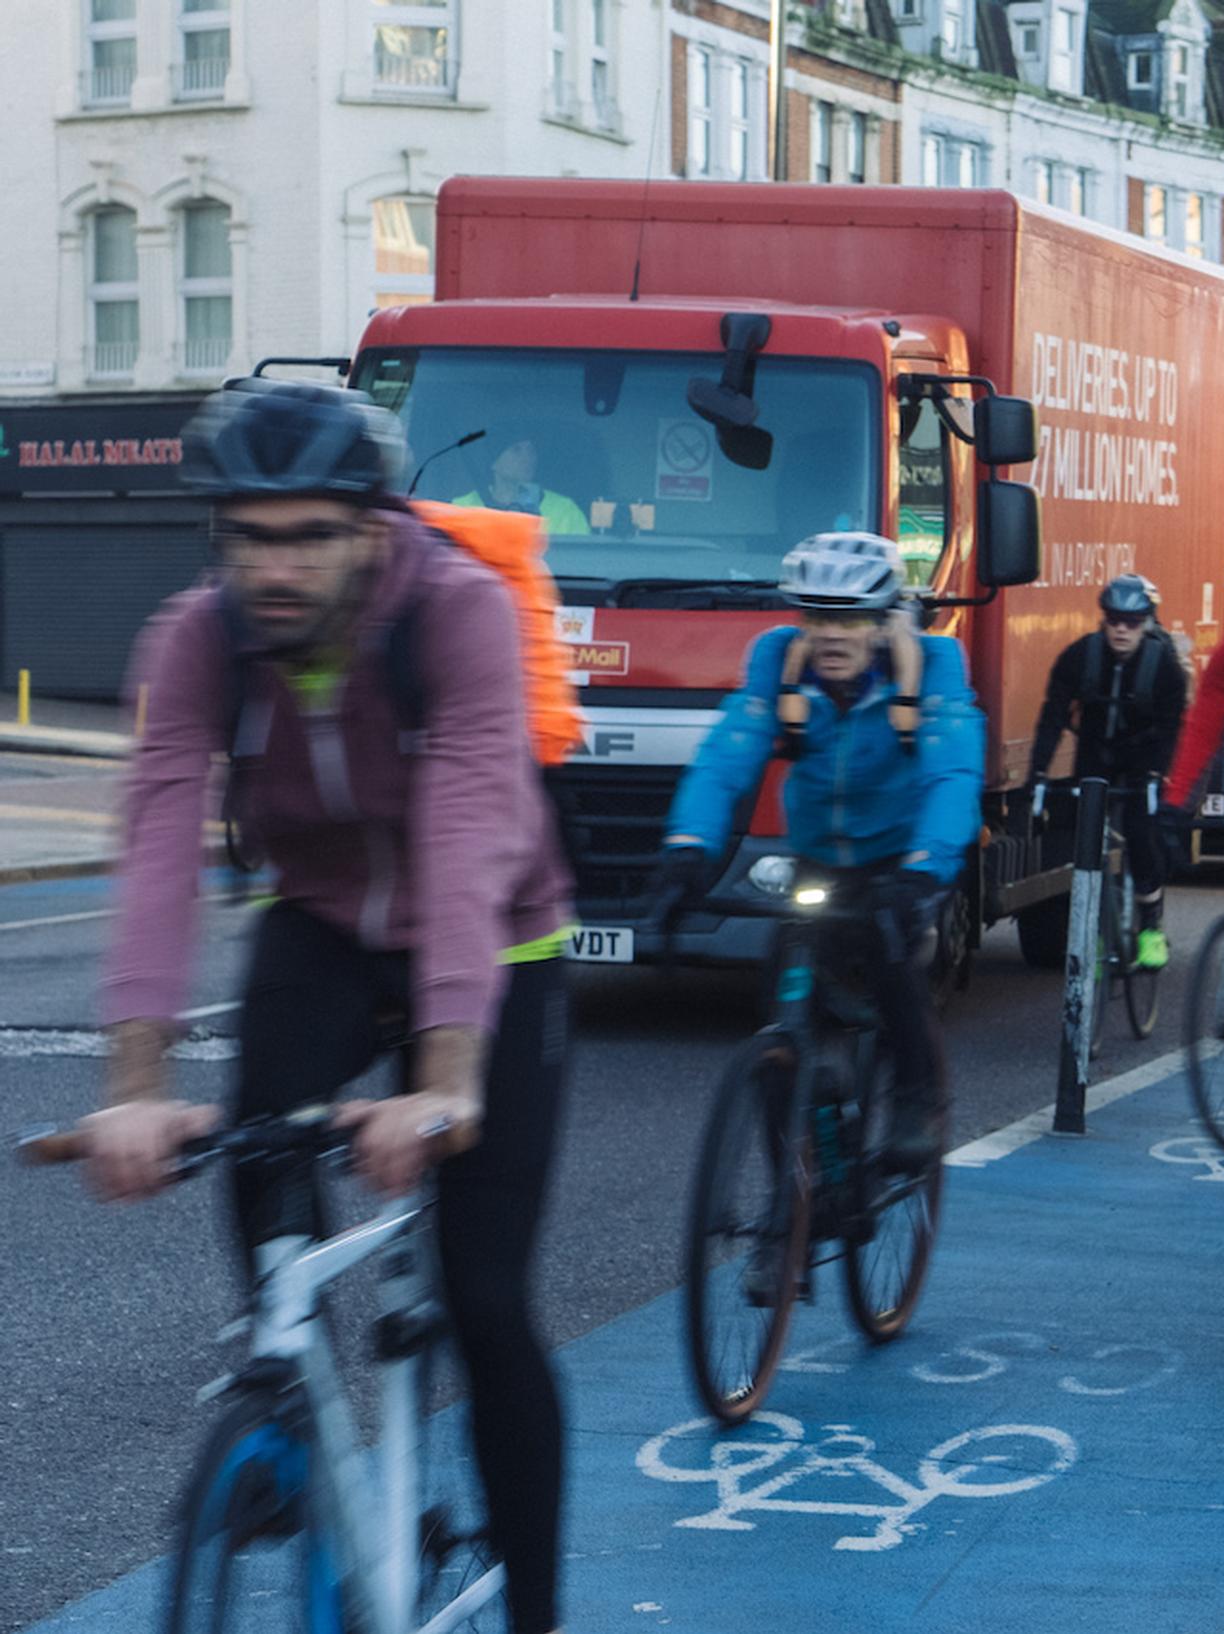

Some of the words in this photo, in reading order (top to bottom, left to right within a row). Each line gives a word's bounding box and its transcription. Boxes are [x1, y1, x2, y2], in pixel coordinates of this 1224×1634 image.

[1135, 354, 1156, 423] UP
[1158, 359, 1178, 428] TO
[19, 440, 100, 467] HALAL
[102, 438, 183, 465] MEATS
[577, 649, 620, 666] Mail
[572, 931, 620, 956] VDT
